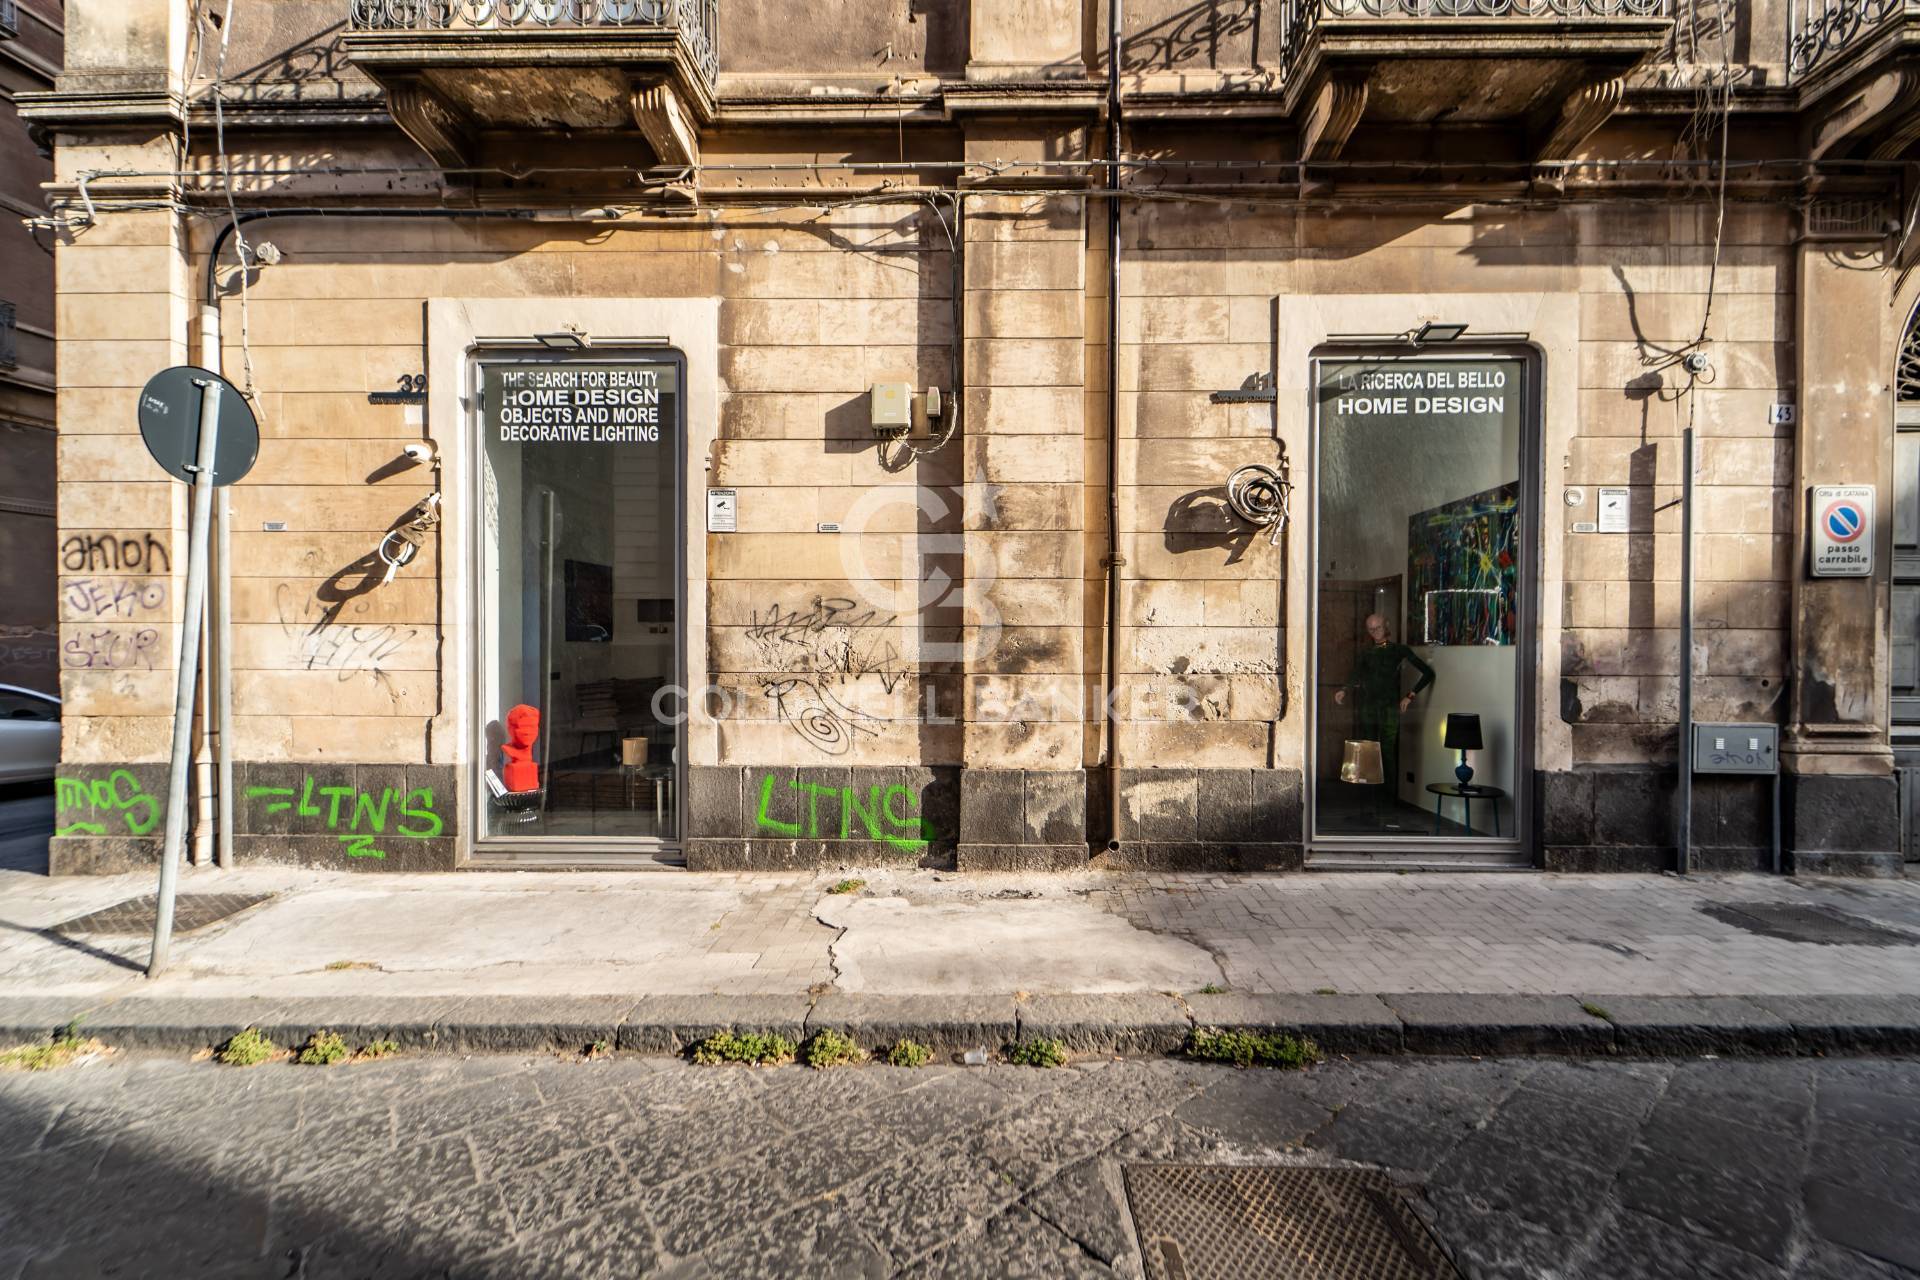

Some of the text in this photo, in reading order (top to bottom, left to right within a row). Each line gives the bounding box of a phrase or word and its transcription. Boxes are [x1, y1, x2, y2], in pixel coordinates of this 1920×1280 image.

[397, 374, 427, 392] 39
[502, 371, 658, 388] THE SEARCH FOR BEAUTY
[1339, 371, 1506, 390] LA RICERCA DEL BELLO
[502, 389, 659, 406] HOME DESIGN
[1338, 397, 1504, 415] HOME DESIGN
[1776, 406, 1792, 421] 43
[500, 408, 659, 424] OBJECTS AND MORE
[500, 426, 659, 441] DECORATIVE LIGHTING
[1827, 545, 1860, 554] passo
[1818, 555, 1868, 564] carrabile
